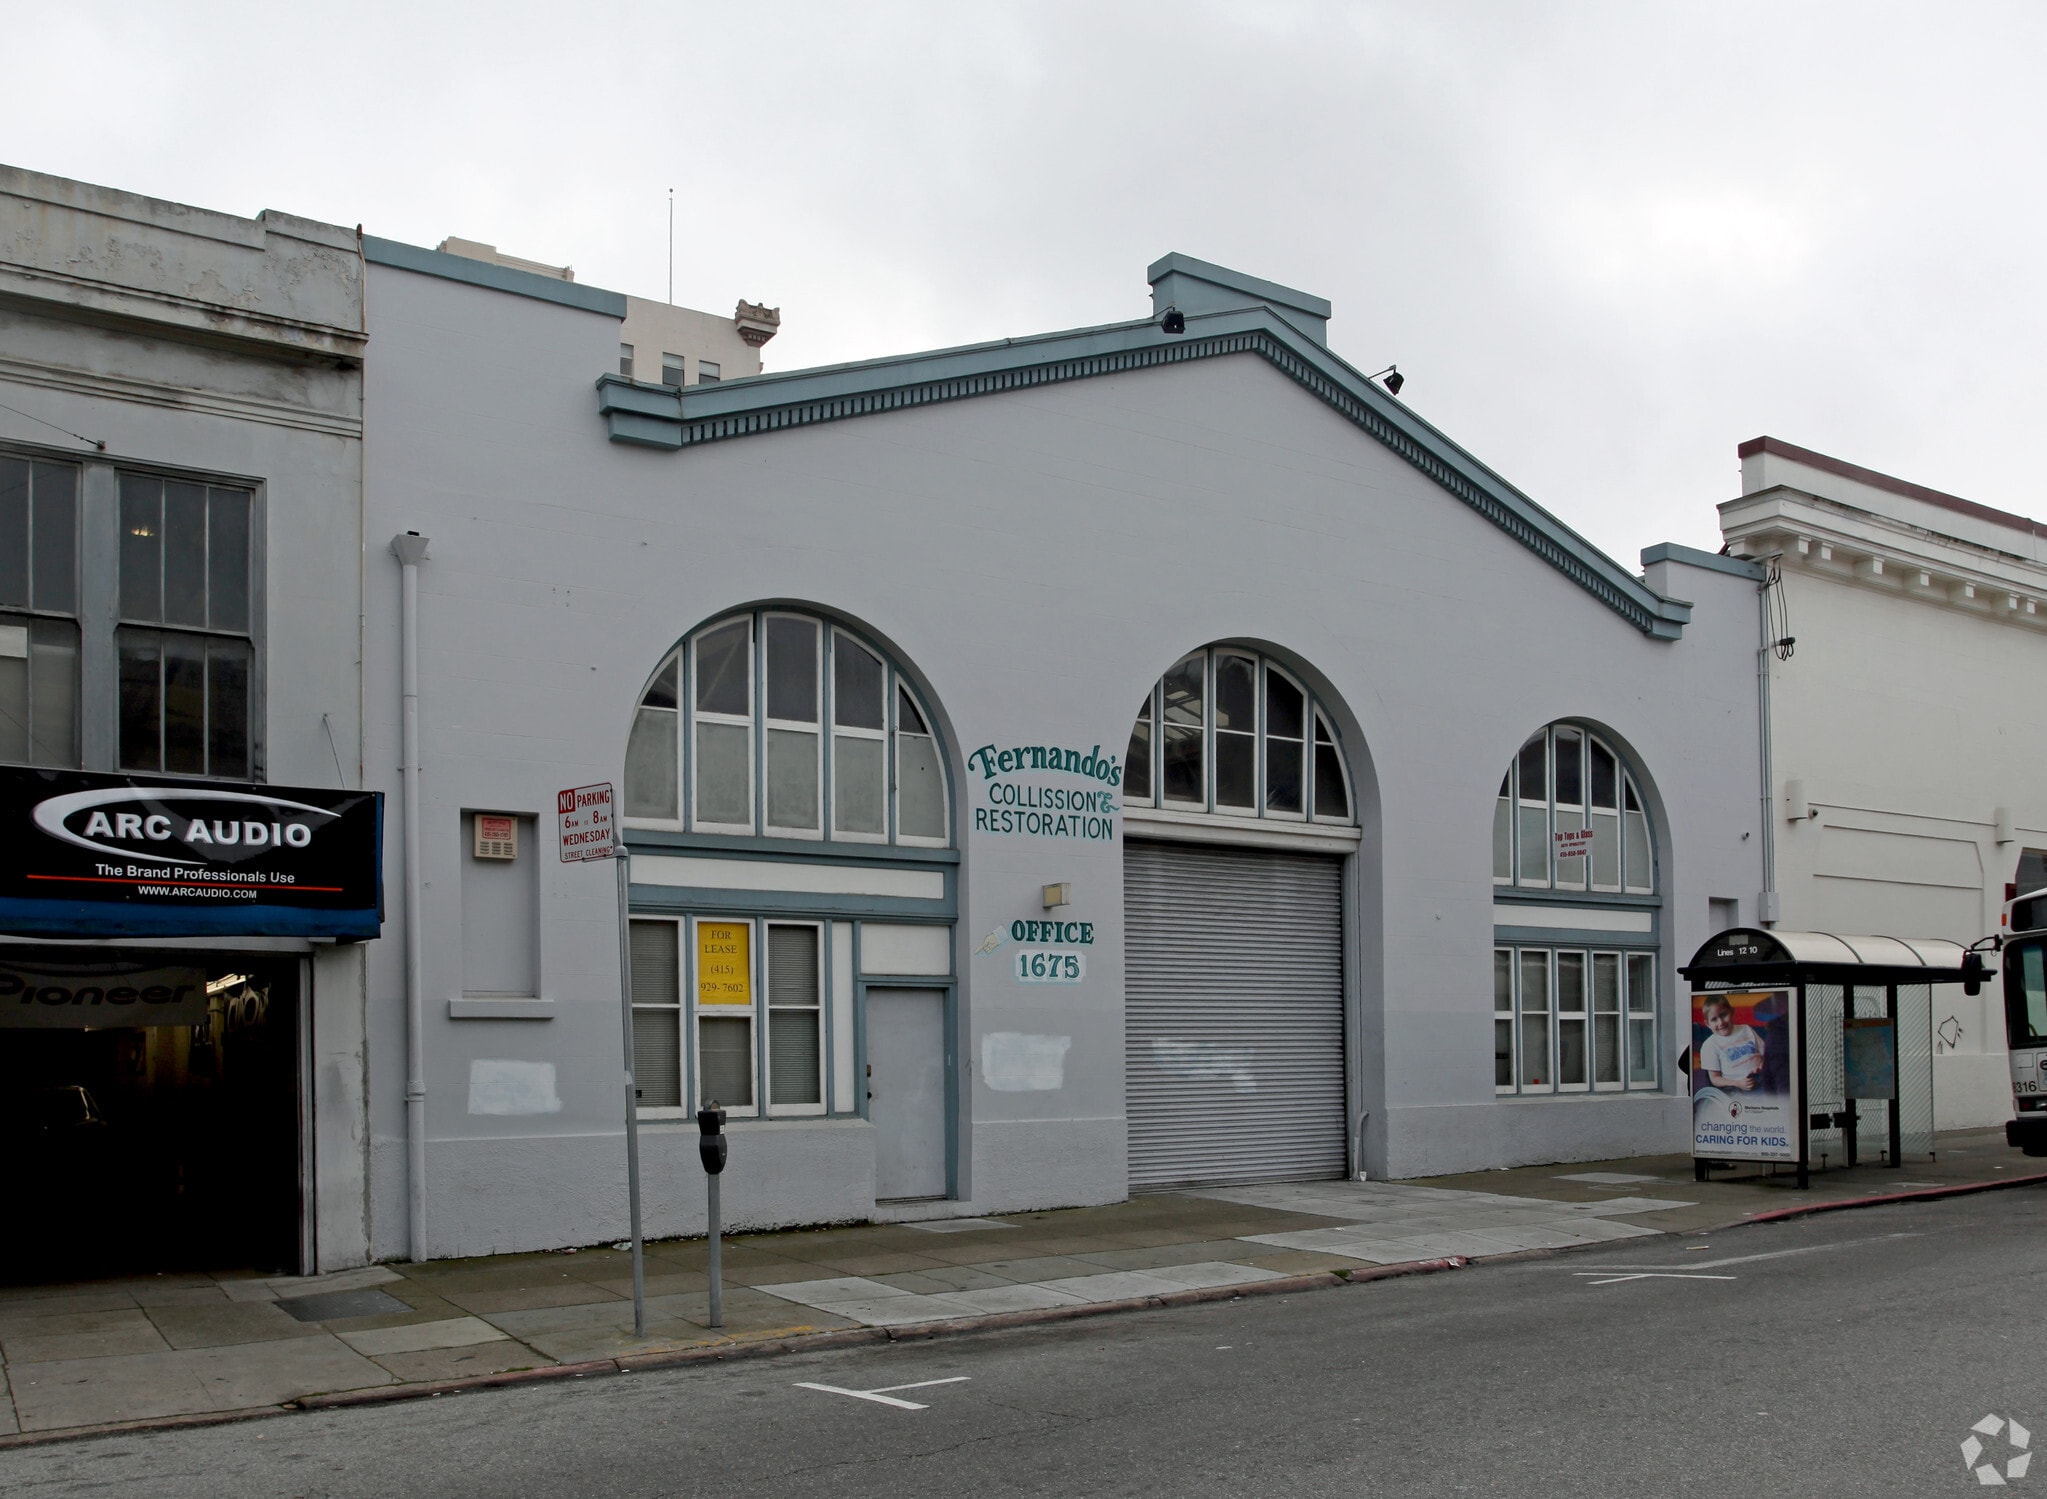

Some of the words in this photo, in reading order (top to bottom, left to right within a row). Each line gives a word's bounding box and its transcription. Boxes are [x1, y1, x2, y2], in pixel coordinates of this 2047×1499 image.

[968, 743, 1122, 787] Fernando's
[560, 791, 573, 811] NO
[577, 789, 610, 808] PARKING
[989, 782, 1096, 812] COLLISSION
[1097, 790, 1120, 813] &
[84, 811, 172, 841] ARC
[184, 818, 312, 848] AUDIO
[976, 808, 1113, 840] RESTORATION
[562, 828, 611, 846] WEDNESDAY
[564, 851, 584, 860] STREET
[585, 847, 611, 857] CLEANING
[96, 864, 124, 876] The
[127, 865, 171, 879] Brand
[174, 867, 267, 883] Professionals
[270, 872, 295, 883] Use
[138, 886, 257, 899] WWW.ARCAUDIO.COM
[711, 930, 731, 940] FOR
[1011, 920, 1094, 945] OFFICE
[704, 944, 737, 954] LEASE
[1739, 946, 1747, 955] 12
[1749, 946, 1758, 954] 10
[710, 964, 734, 976] (415)
[1021, 953, 1080, 979] 1675
[1701, 1121, 1747, 1135] changing
[1696, 1134, 1734, 1144] CARING
[1737, 1136, 1758, 1145] FOR
[1761, 1137, 1789, 1147] KIDS.
